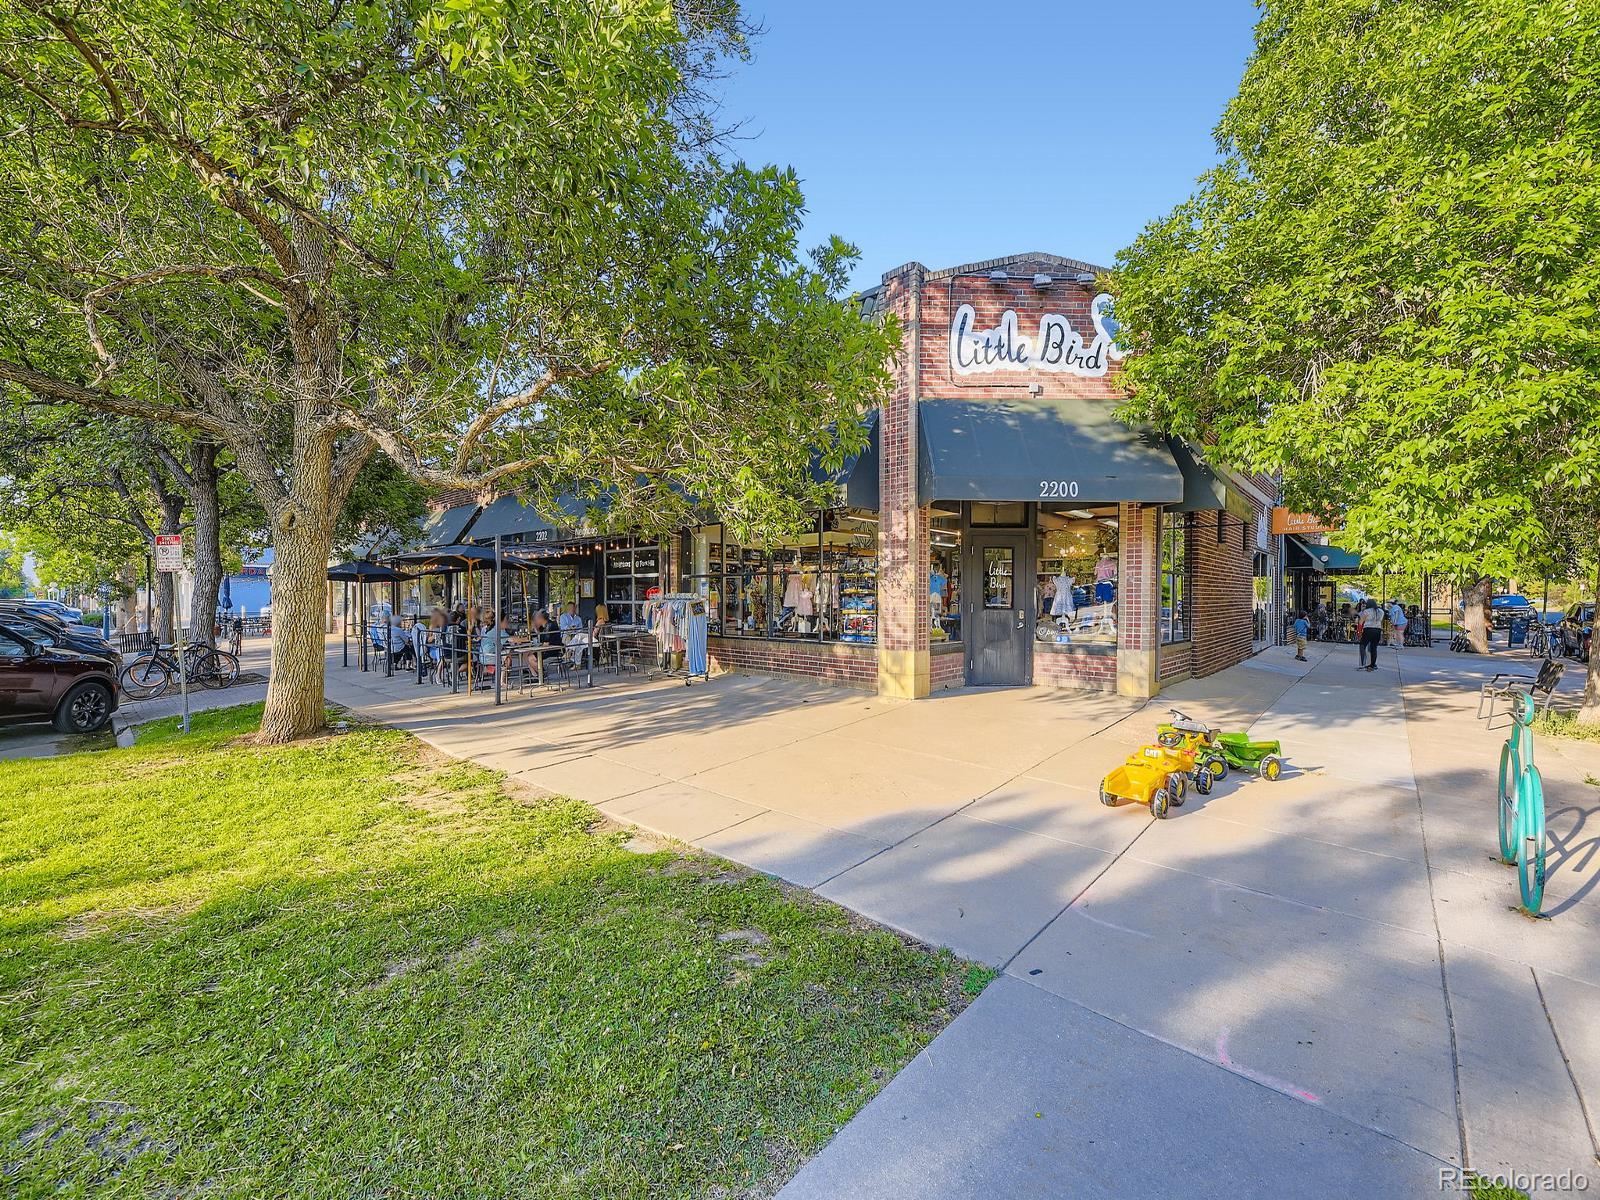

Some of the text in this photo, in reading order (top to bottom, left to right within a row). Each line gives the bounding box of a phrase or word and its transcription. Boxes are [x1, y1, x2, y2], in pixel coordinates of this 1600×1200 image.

[957, 312, 1103, 370] Little Bird
[1039, 480, 1079, 498] 2200
[535, 530, 548, 541] 2202
[988, 560, 1009, 576] Little
[989, 576, 1007, 589] Bird
